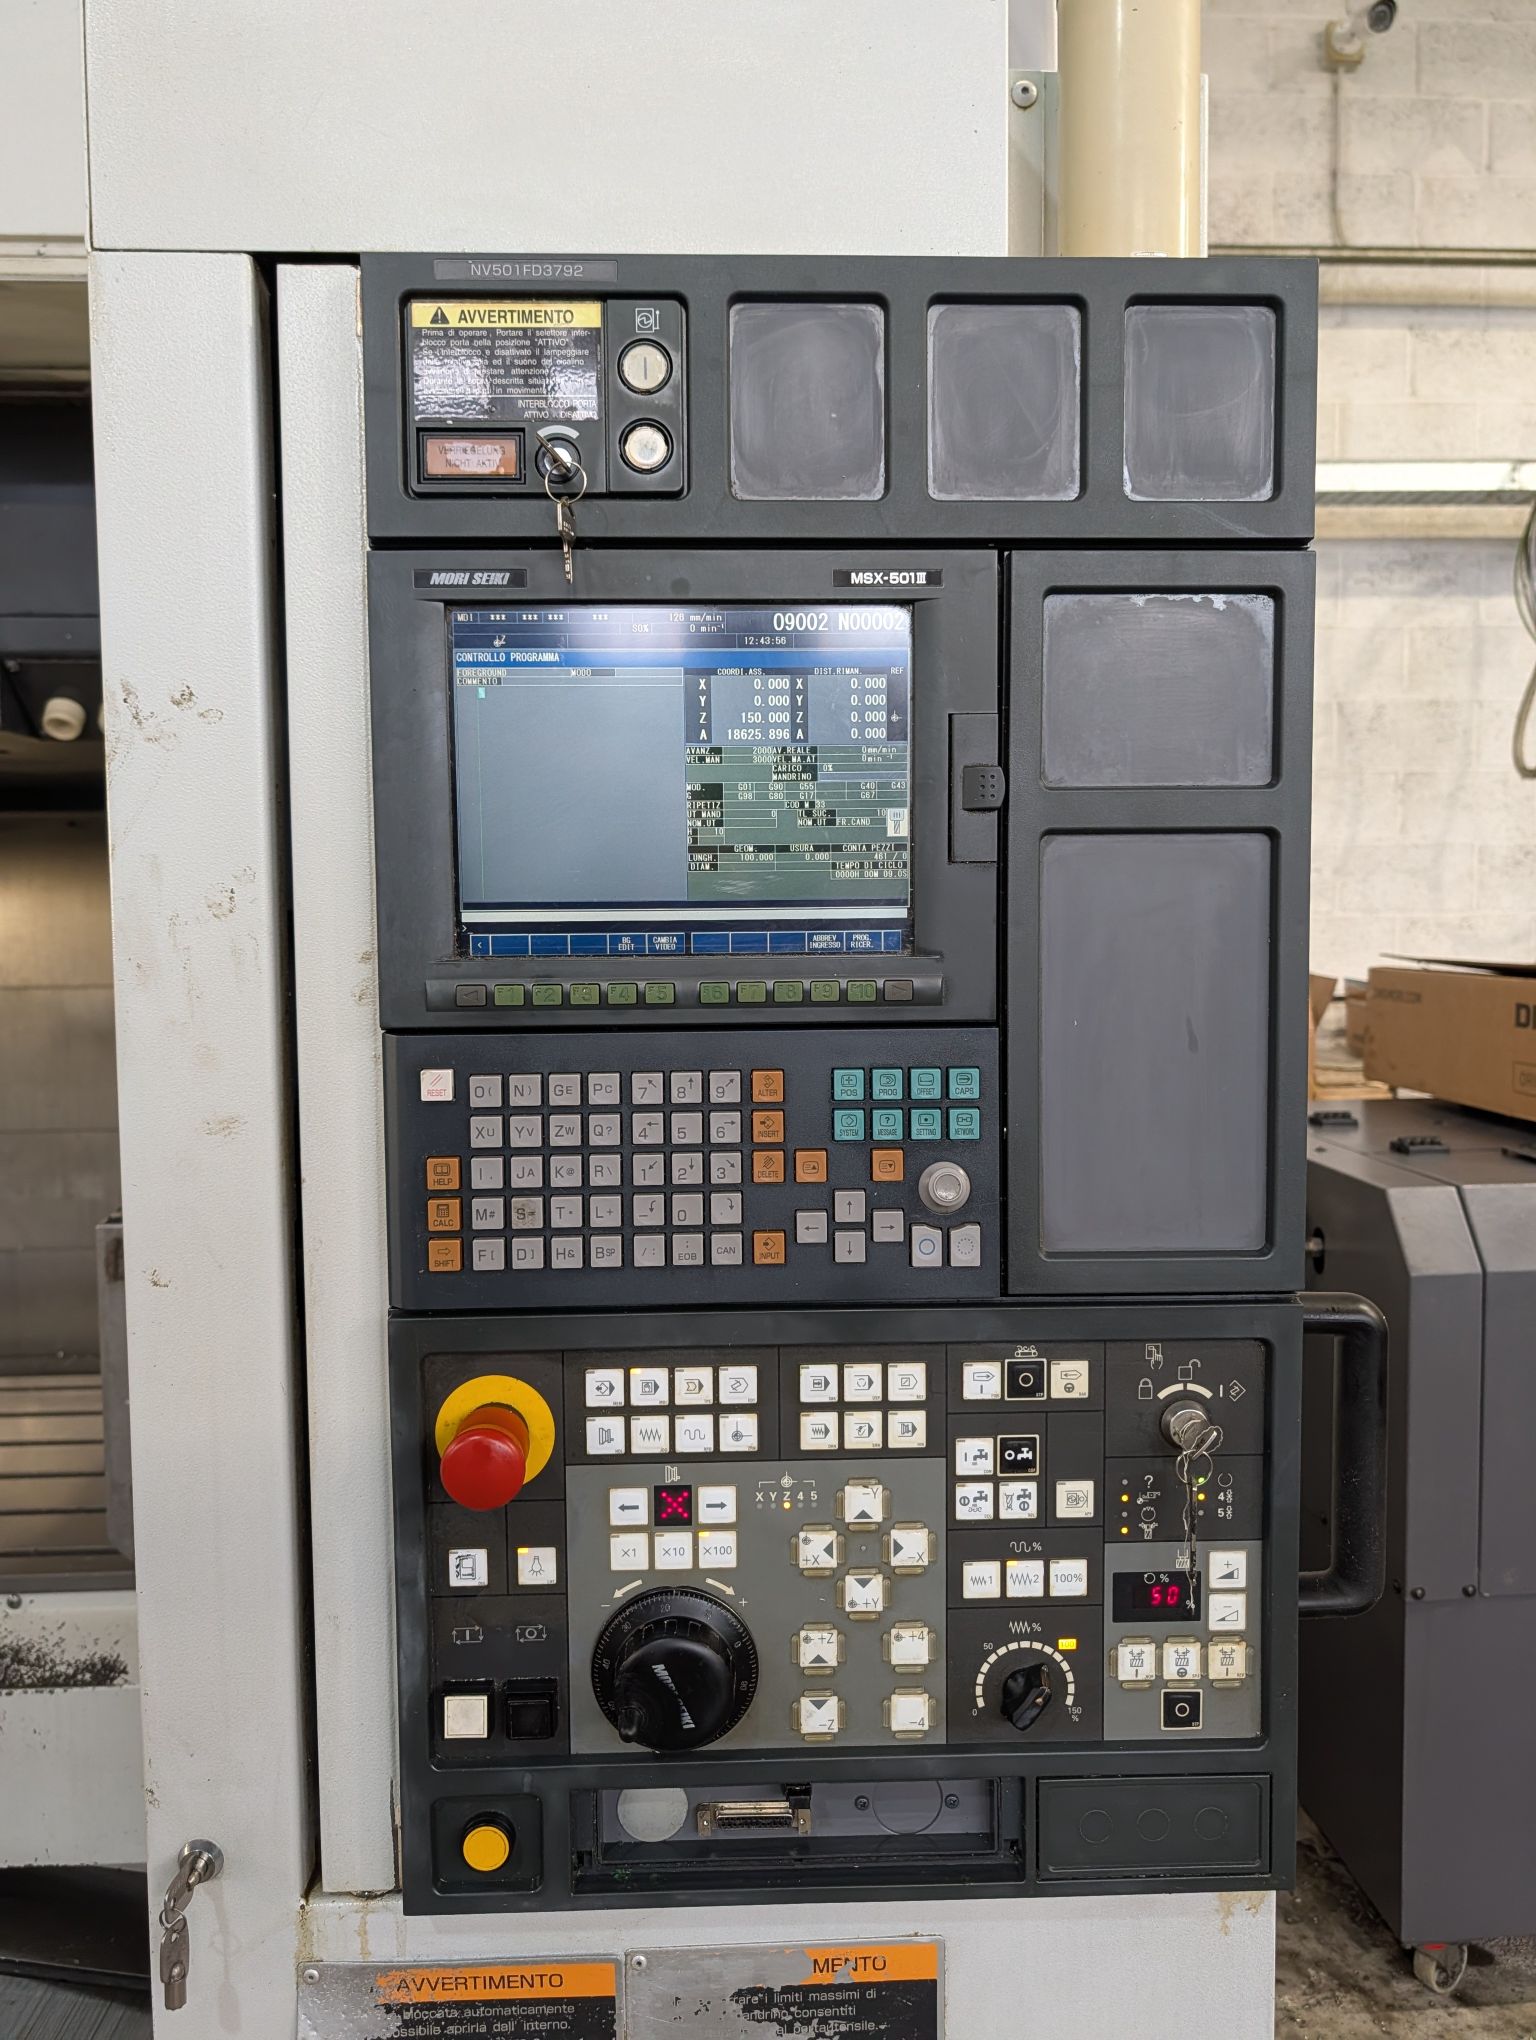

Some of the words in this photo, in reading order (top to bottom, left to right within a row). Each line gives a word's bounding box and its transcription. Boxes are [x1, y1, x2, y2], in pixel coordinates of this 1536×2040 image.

[470, 263, 584, 277] NV501FD3792
[458, 309, 574, 324] AVVERTIMENTO
[422, 329, 444, 338] Prima
[496, 329, 523, 338] Portare
[536, 329, 567, 338] selettore
[422, 338, 446, 347] blocco
[496, 338, 530, 347] posizione
[494, 348, 532, 356] disattivato
[544, 348, 589, 356] lampeggiare
[523, 411, 549, 419] ATTIVO
[430, 572, 470, 585] MORI
[471, 572, 510, 585] SEIKI
[690, 612, 722, 623] mm/min
[838, 612, 906, 631] N00002
[744, 636, 787, 645] 12:43:56
[456, 652, 506, 662] CONTROLLO
[510, 652, 560, 662] PROGRAMMA
[456, 669, 507, 677] FOREGROUND
[570, 669, 592, 677] MODO
[890, 666, 904, 674] REF
[456, 678, 498, 686] COMMENTO
[698, 678, 706, 690] X
[754, 678, 790, 690] 0.000
[796, 678, 804, 690] X
[850, 678, 886, 689] 0.000
[698, 695, 707, 706] Y
[754, 695, 790, 706] 0.000
[796, 694, 804, 706] Y
[850, 694, 886, 706] 0.000
[699, 712, 707, 724] Z
[740, 712, 790, 724] 150.000
[796, 712, 804, 723] Z
[850, 711, 886, 722] 0.000
[700, 730, 708, 740] A
[727, 728, 790, 740] 18625.896
[796, 728, 804, 740] A
[850, 728, 886, 739] 0.000
[686, 746, 714, 755] AVANZ.
[752, 746, 772, 754] 2000
[772, 746, 810, 754] AV.REALE
[686, 756, 720, 764] VEL.MAN
[772, 764, 802, 772] CARICO
[768, 783, 783, 791] G90
[799, 782, 814, 790] G55
[687, 801, 720, 810] RIPETIZ
[812, 809, 831, 817] SUC.
[790, 844, 814, 852] USURA
[842, 844, 867, 852] CONTA
[688, 854, 716, 862] LUNGH.
[690, 863, 714, 871] DIAM.
[836, 861, 860, 869] TEMPO
[864, 861, 873, 869] DI
[878, 861, 903, 869] CICLO
[652, 936, 678, 944] CAMBIA
[812, 934, 837, 942] ABBREV
[809, 941, 841, 949] INGRESSO
[426, 1088, 446, 1097] RESET
[638, 1087, 648, 1099] 7
[676, 1086, 687, 1099] 8
[715, 1086, 725, 1098] 9
[758, 1089, 778, 1097] ALTER
[840, 1088, 858, 1097] POS
[878, 1088, 898, 1096] PROG
[916, 1088, 936, 1096] OFFSET
[954, 1087, 974, 1095] CAPS
[758, 1130, 780, 1138] INSERT
[839, 1128, 859, 1137] SYSTEM
[878, 1128, 898, 1136] MESSAGE
[916, 1128, 936, 1136] SETTING
[954, 1128, 975, 1136] NETWORK
[758, 1170, 779, 1179] DELETE
[432, 1178, 453, 1186] HELP
[432, 1218, 454, 1227] CALC
[716, 1246, 736, 1255] CAN
[678, 1253, 697, 1261] EOB
[759, 1252, 780, 1260] INPUT
[434, 1260, 456, 1268] SHIFT
[755, 1492, 764, 1501] X
[770, 1492, 777, 1501] Y
[783, 1492, 790, 1501] Z
[796, 1492, 804, 1501] 4
[810, 1492, 818, 1501] 5
[1056, 1573, 1083, 1583] 100%
[1151, 1586, 1180, 1606] 50
[983, 1642, 994, 1651] 50
[1067, 1706, 1082, 1715] 150
[396, 1974, 564, 1992] AVVERTIMENTO
[774, 1992, 802, 2004] limiti
[809, 1990, 860, 2002] massimi
[866, 1988, 876, 1999] di
[463, 2004, 575, 2018] automaticamente
[795, 2005, 856, 2018] consentiti
[524, 2021, 571, 2032] interno.
